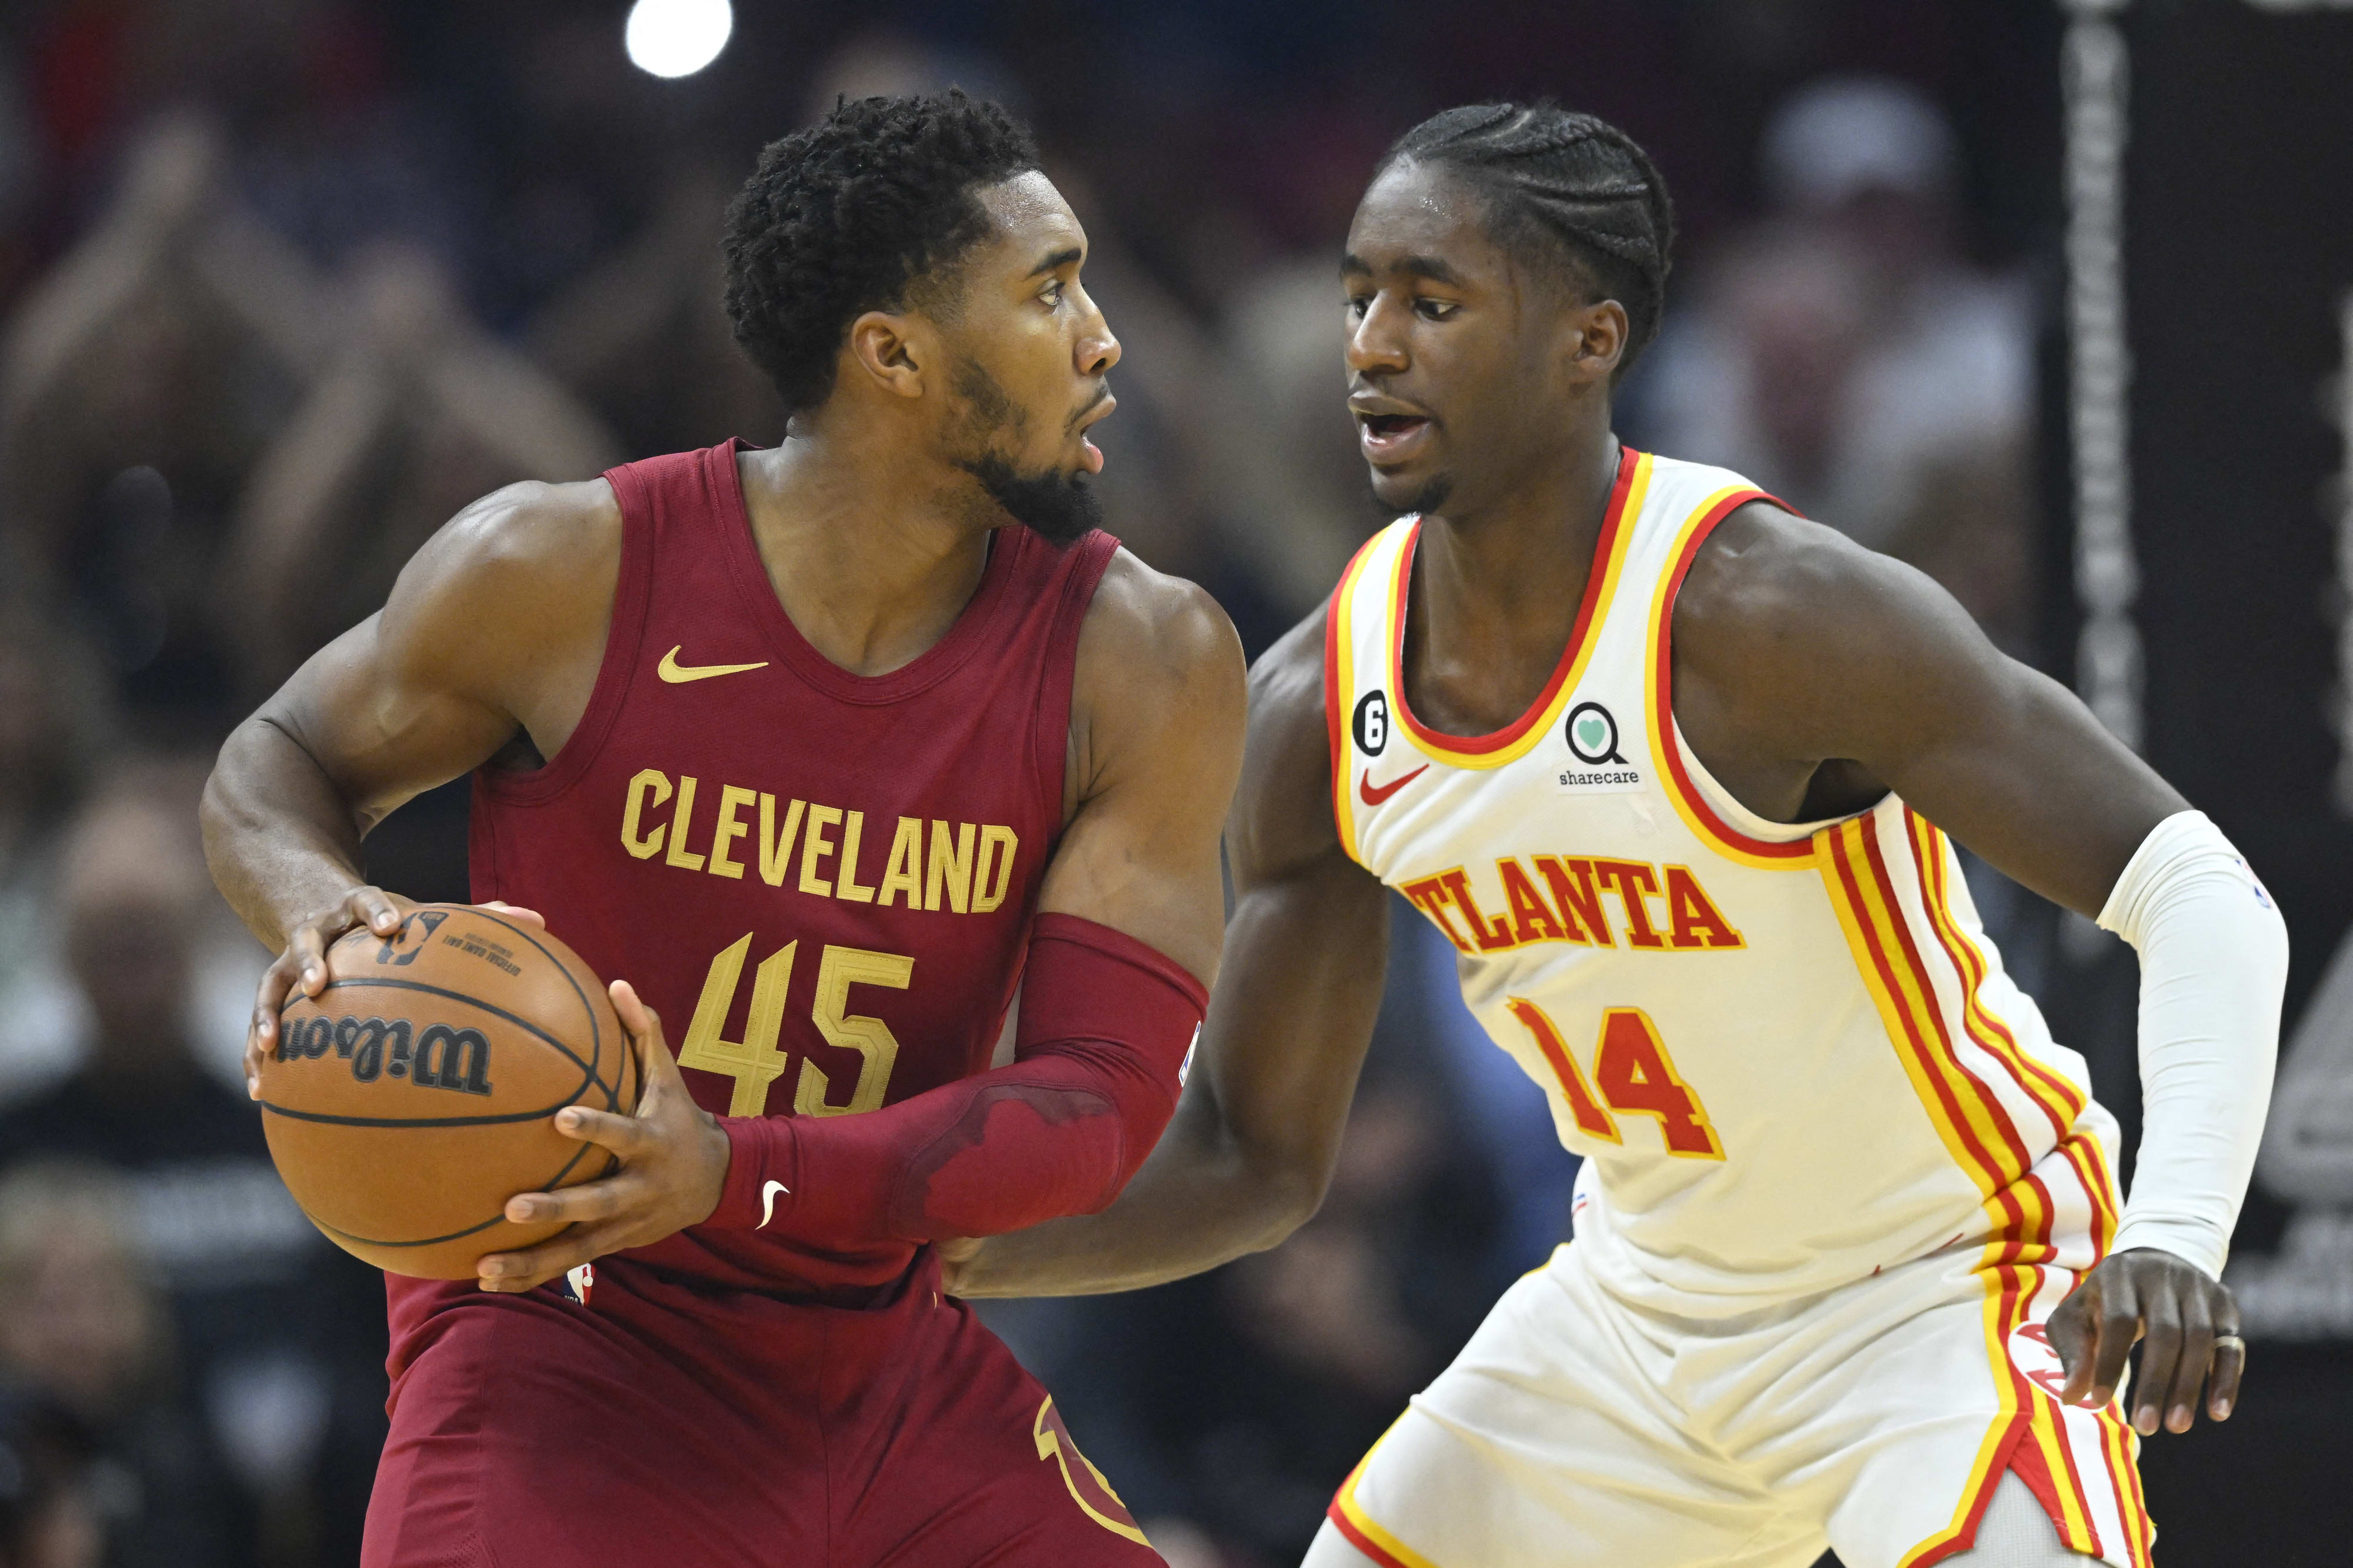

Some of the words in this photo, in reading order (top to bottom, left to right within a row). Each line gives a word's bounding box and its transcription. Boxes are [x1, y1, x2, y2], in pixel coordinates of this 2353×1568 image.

[1364, 699, 1384, 749] 6
[1559, 770, 1639, 785] sharecare
[621, 768, 1018, 914] CLEVELAND
[1397, 855, 1748, 956] TLANTA
[276, 1015, 493, 1096] Wilson
[676, 932, 915, 1118] 45
[1505, 995, 1727, 1162] 14
